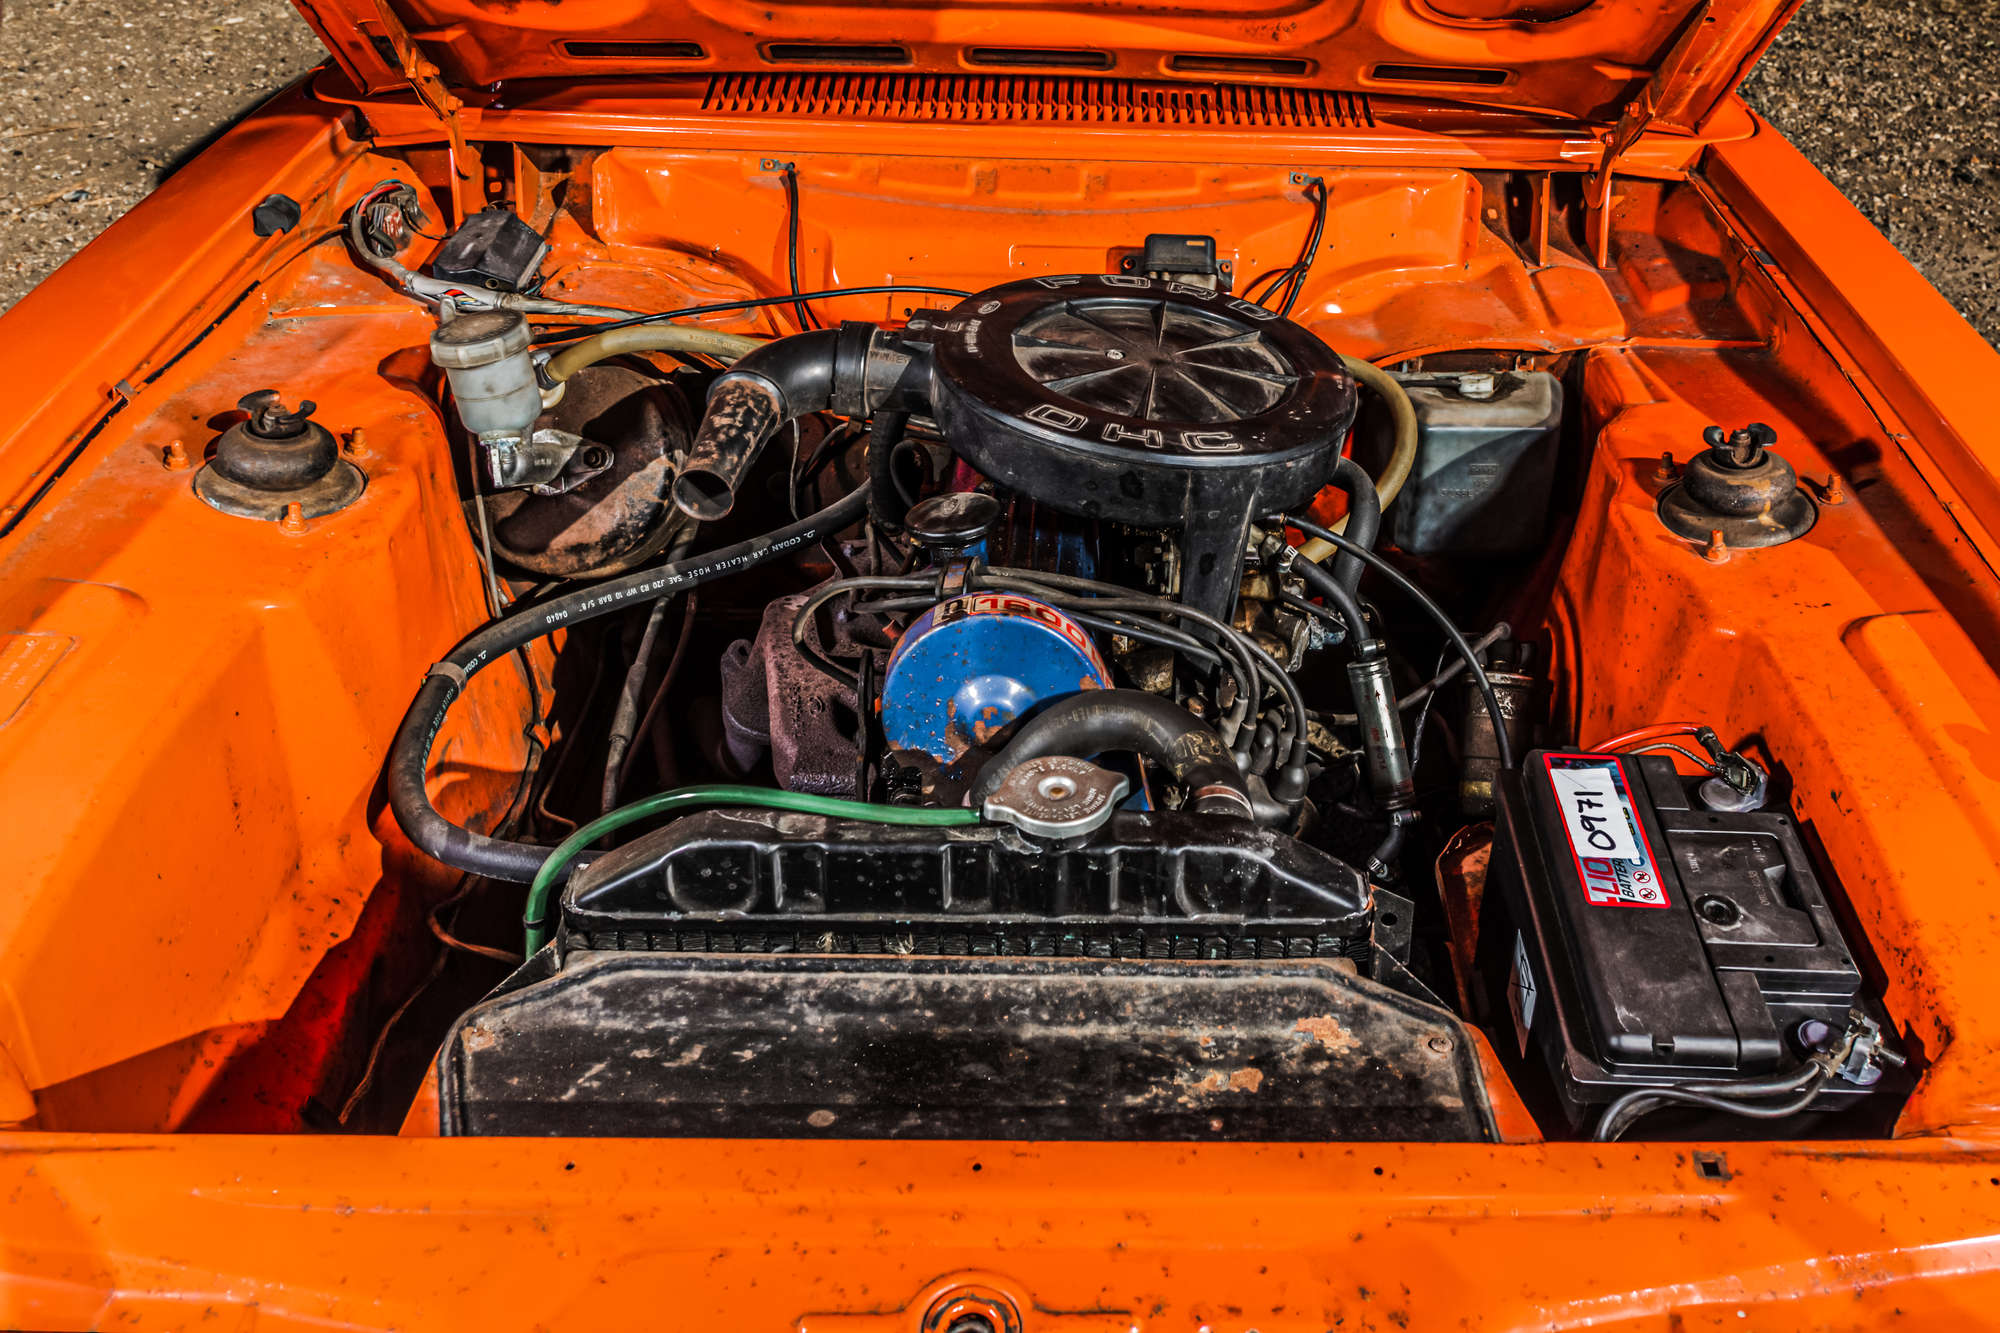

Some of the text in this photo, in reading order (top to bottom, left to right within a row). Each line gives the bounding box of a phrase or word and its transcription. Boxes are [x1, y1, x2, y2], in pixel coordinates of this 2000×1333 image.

[1033, 273, 1280, 321] FORD
[1025, 403, 1243, 452] OHC
[771, 537, 801, 552] CODAN
[752, 547, 769, 559] CAR
[668, 574, 683, 585] SAE
[687, 566, 711, 579] HOSE
[652, 579, 665, 588] J20
[598, 593, 613, 605] BAR
[979, 597, 1086, 649] 1600
[463, 658, 478, 675] CODA
[1573, 791, 1616, 851] 0971
[1583, 857, 1621, 896] LIO
